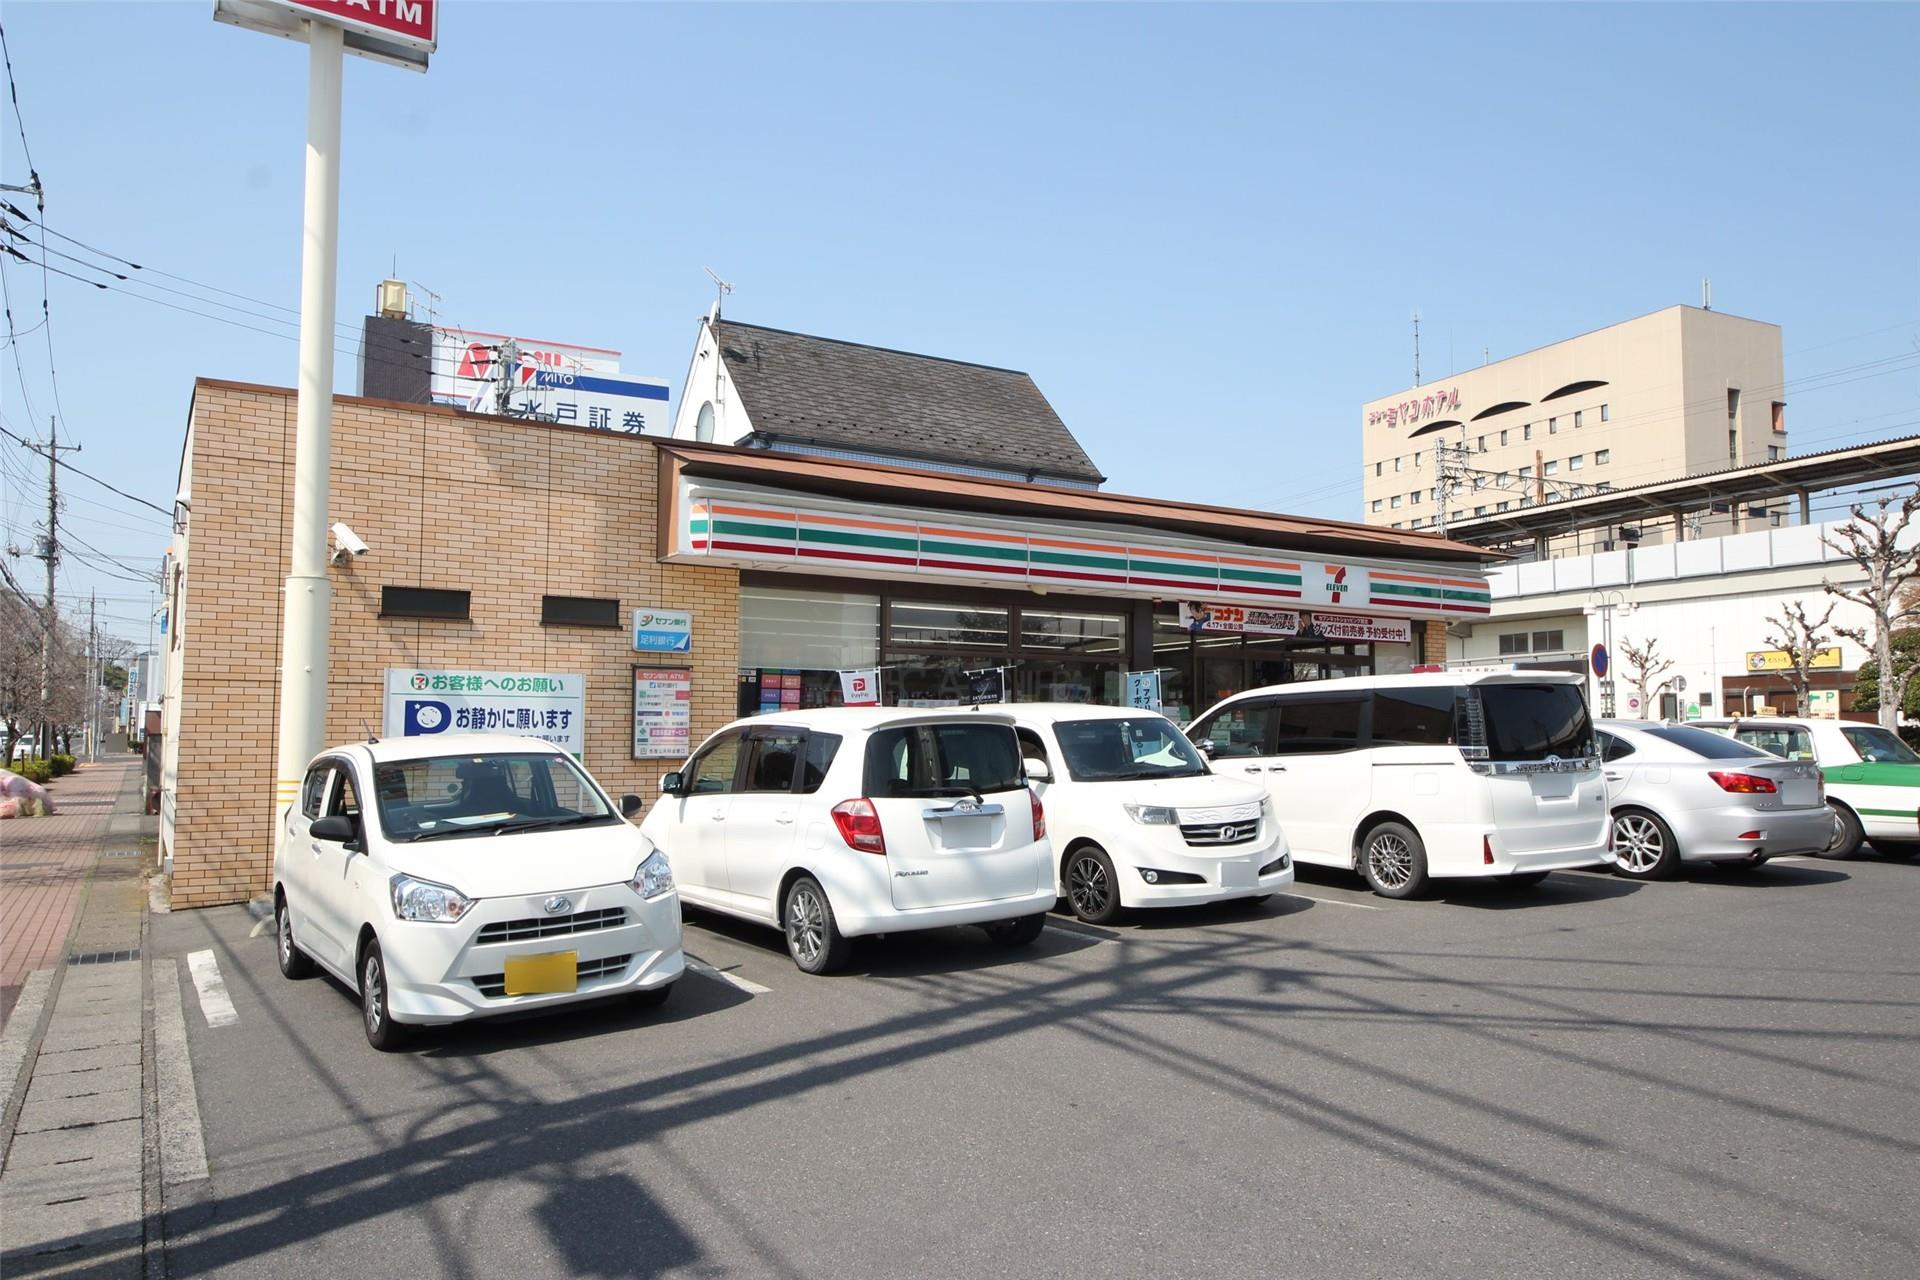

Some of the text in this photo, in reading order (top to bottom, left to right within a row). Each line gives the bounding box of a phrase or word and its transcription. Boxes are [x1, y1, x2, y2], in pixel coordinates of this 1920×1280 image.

[539, 372, 574, 385] MITO
[655, 617, 687, 626] セブン銀行
[1214, 608, 1244, 623] コナン
[1313, 623, 1366, 637] グッズ付前売券
[640, 634, 675, 646] 足利銀行
[432, 674, 564, 693] お客様へのお願い
[1133, 679, 1142, 709] クーポ
[456, 707, 573, 730] お静かに願います
